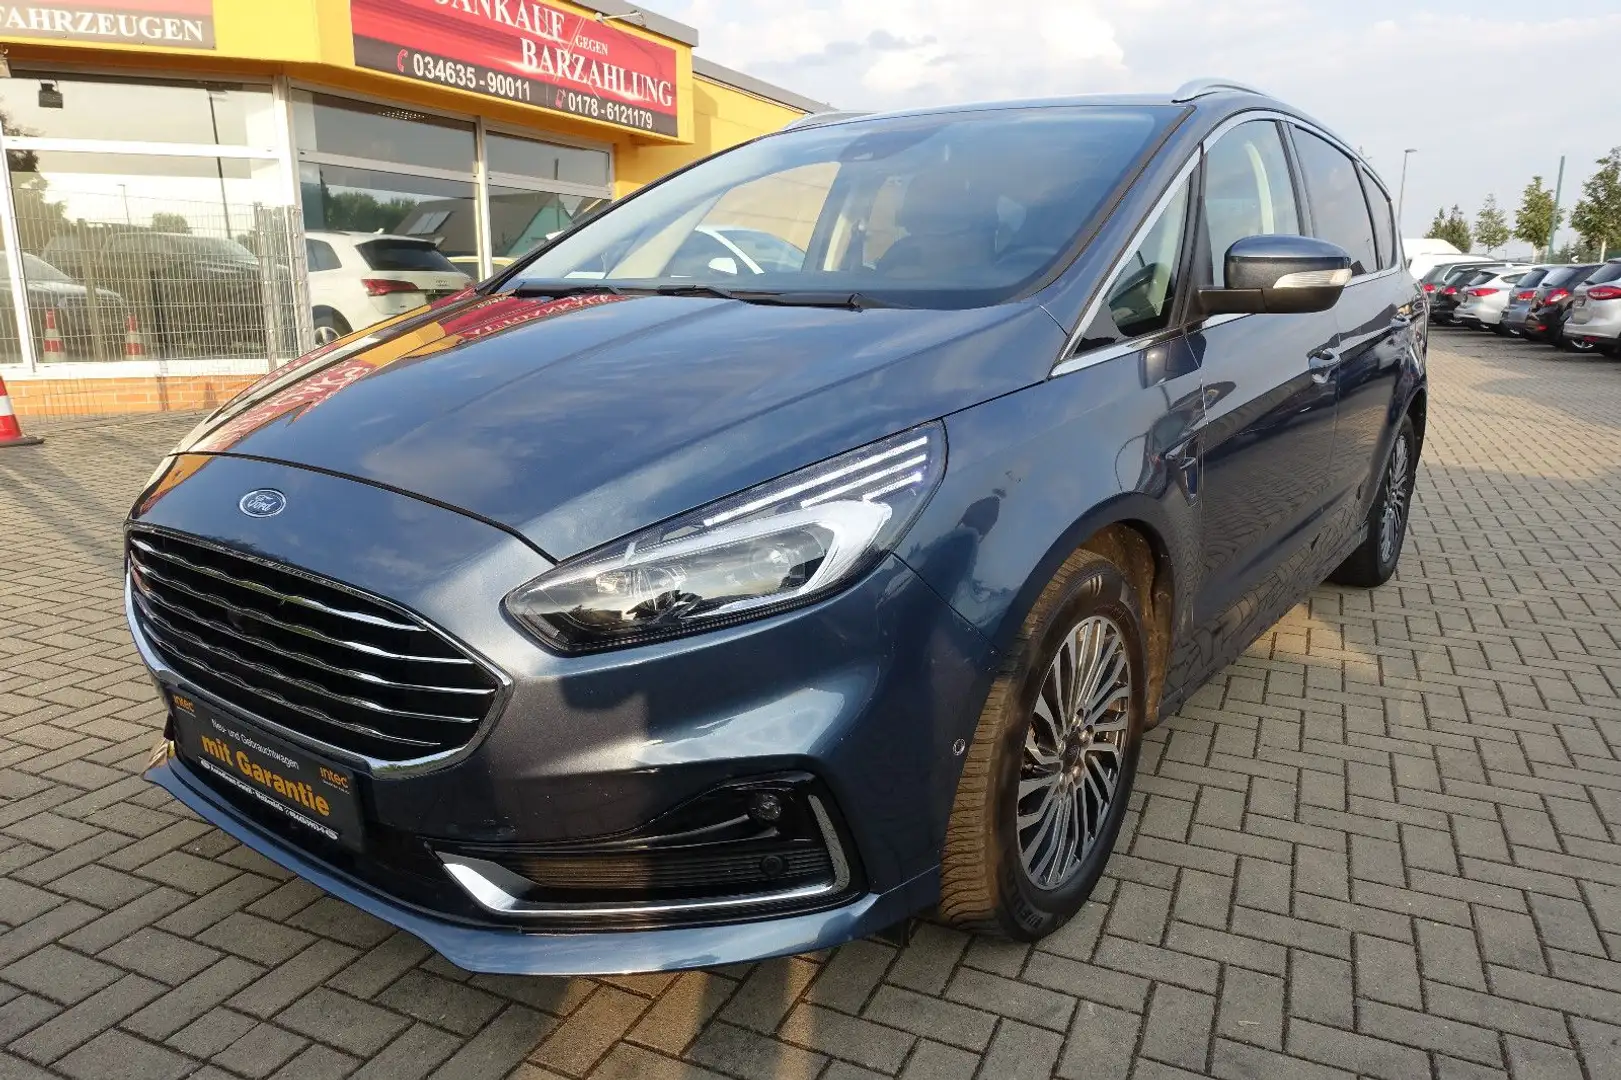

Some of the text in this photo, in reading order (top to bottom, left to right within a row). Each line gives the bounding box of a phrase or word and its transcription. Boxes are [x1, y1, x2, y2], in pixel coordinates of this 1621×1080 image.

[520, 37, 673, 107] BARZAHLUNG
[575, 34, 608, 56] GEGEN
[200, 734, 234, 767] mit
[236, 750, 331, 817] Garantie
[227, 728, 241, 741] und
[240, 733, 300, 771] Gebrauchtwagen
